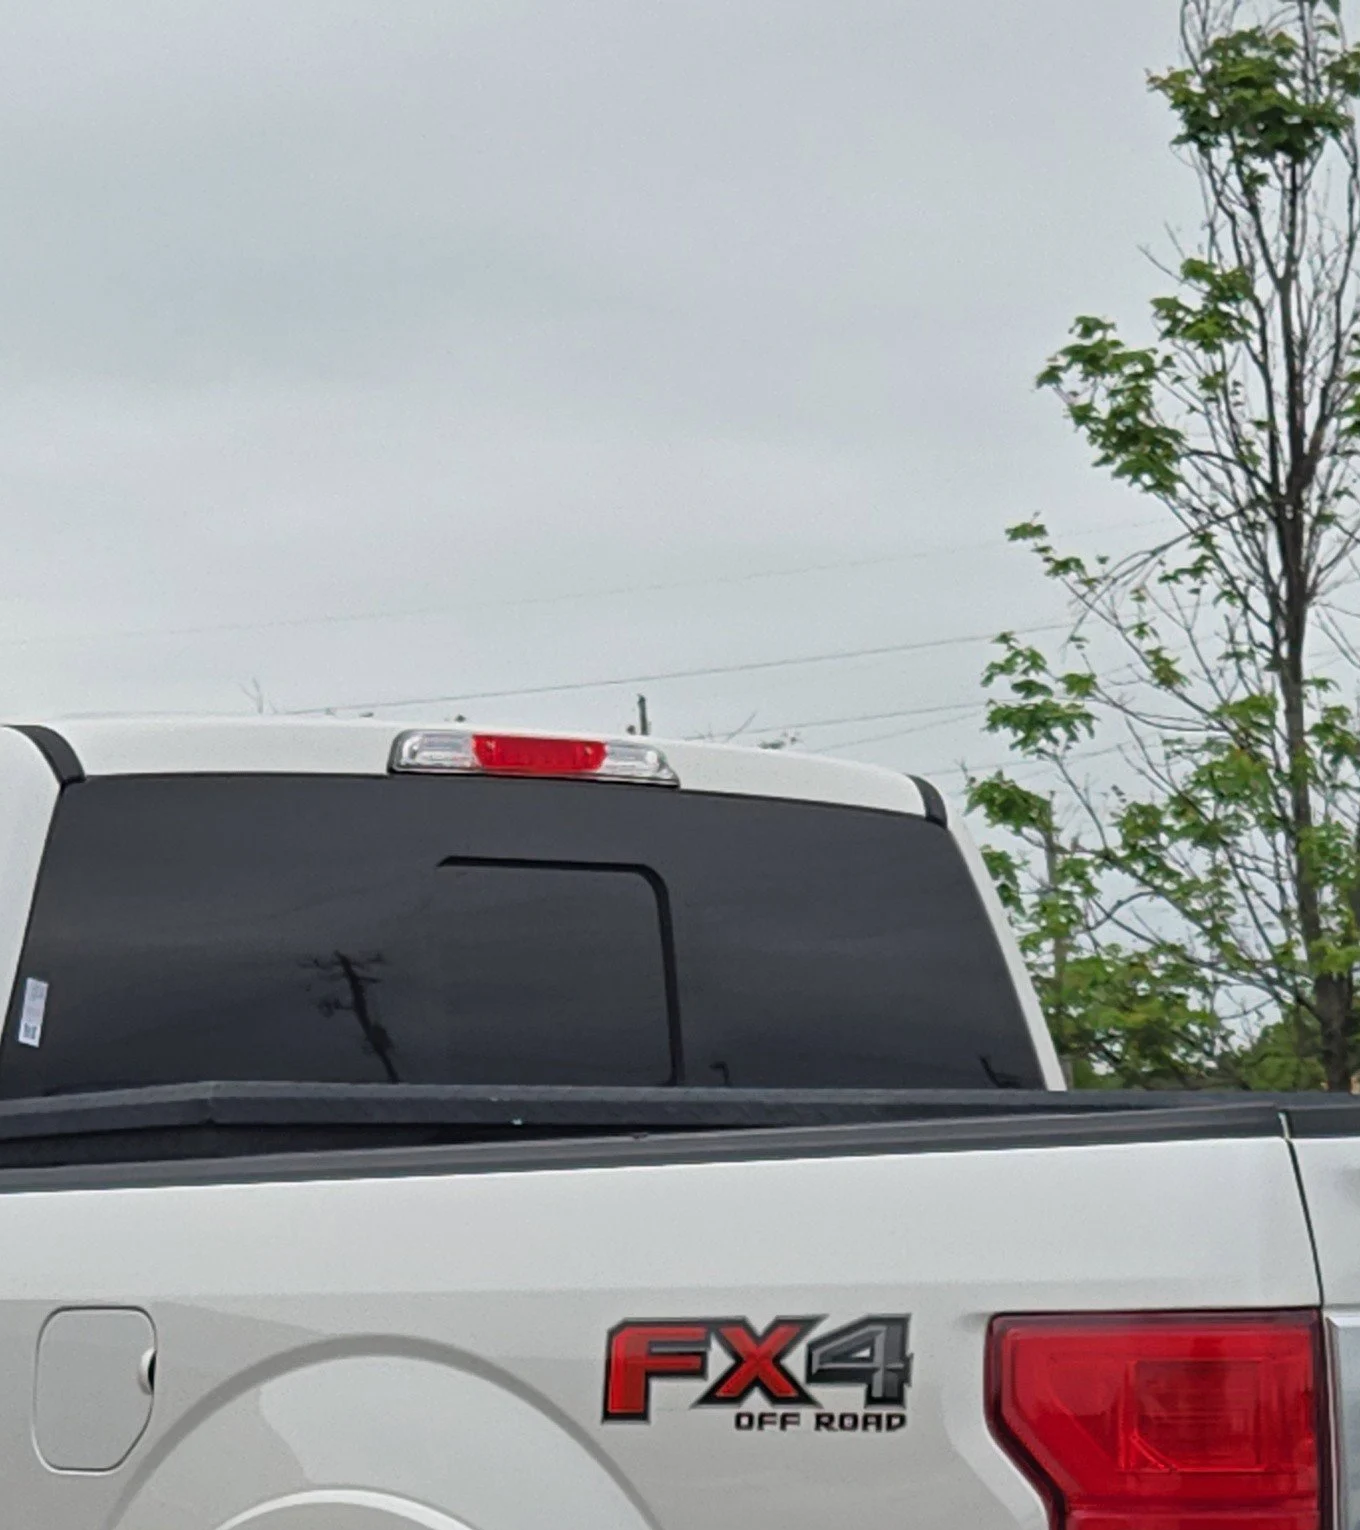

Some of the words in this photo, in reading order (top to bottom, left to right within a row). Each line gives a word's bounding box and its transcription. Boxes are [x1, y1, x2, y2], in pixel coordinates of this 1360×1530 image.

[602, 1313, 914, 1424] FX4
[734, 1412, 802, 1432] OFF
[813, 1412, 907, 1432] ROAD
